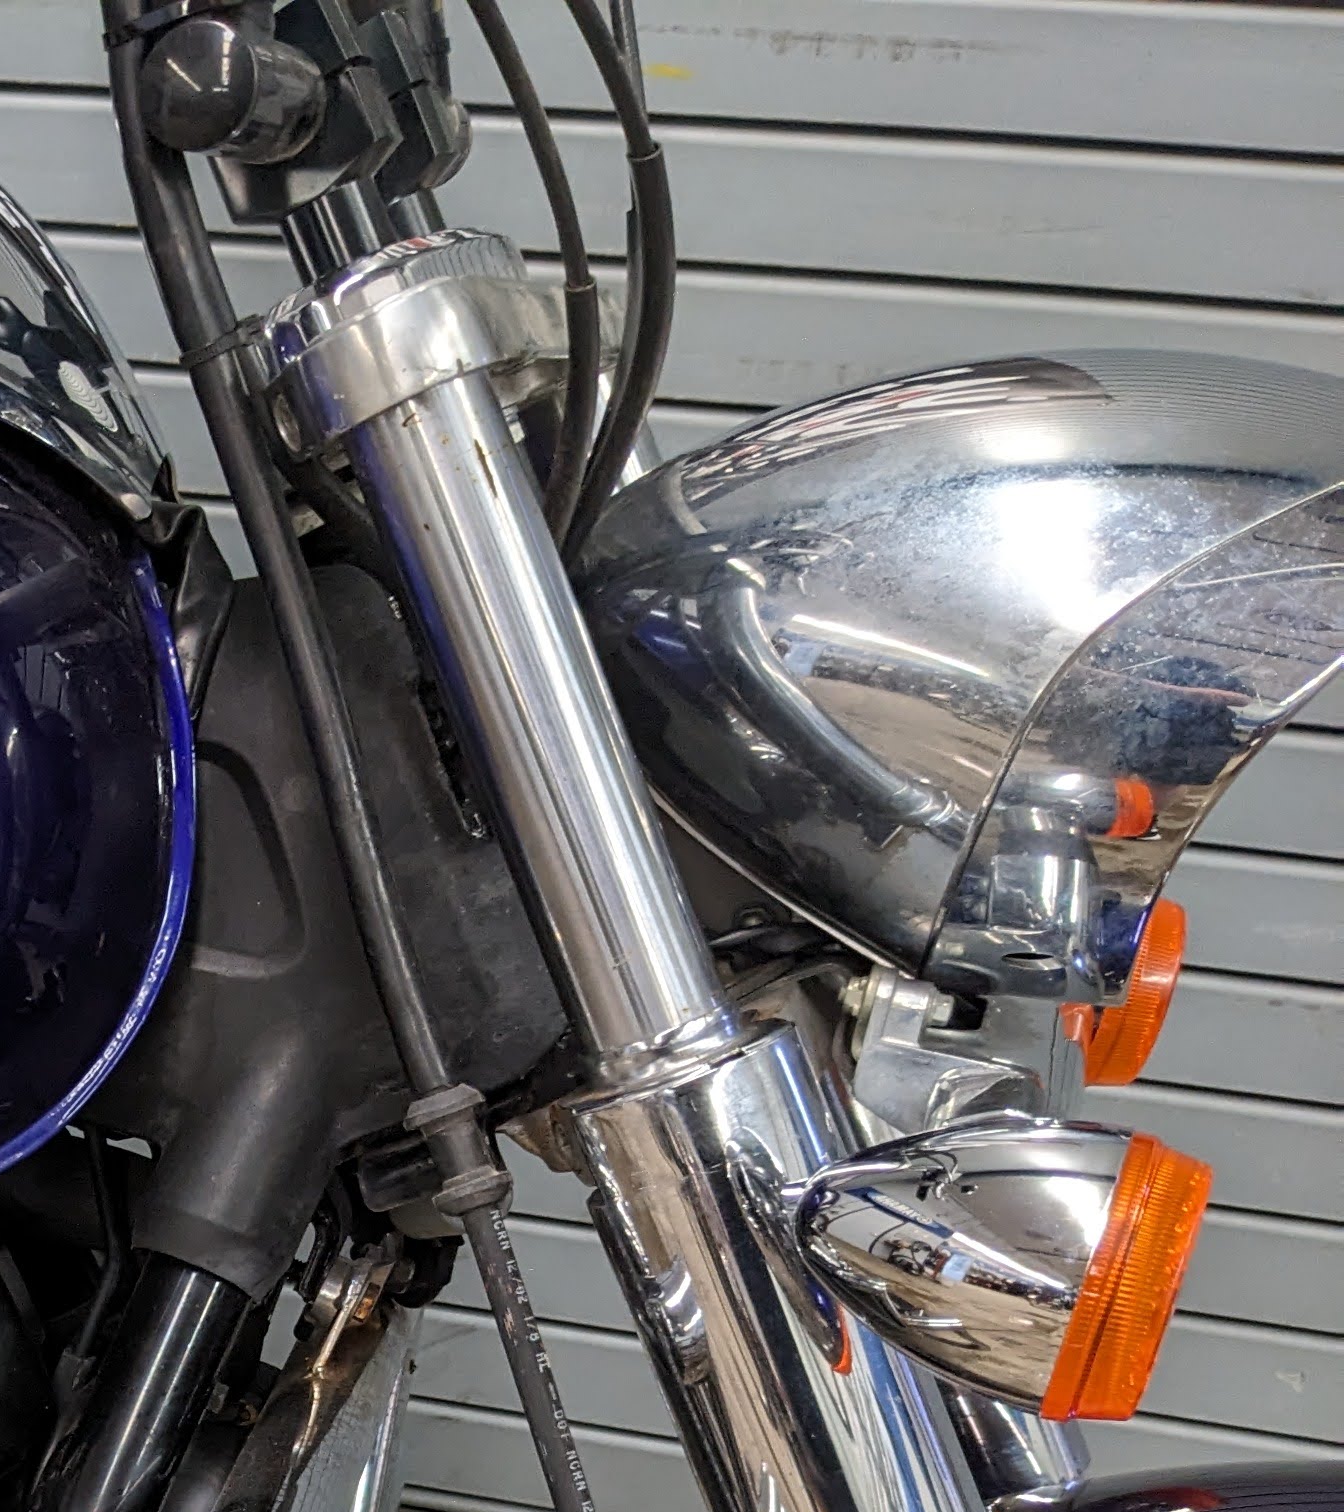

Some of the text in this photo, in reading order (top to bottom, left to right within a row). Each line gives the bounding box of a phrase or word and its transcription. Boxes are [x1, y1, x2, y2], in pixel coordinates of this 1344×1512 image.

[490, 1209, 512, 1251] NCRN
[505, 1259, 529, 1305] 12/02
[523, 1315, 540, 1342] 1/8
[566, 1449, 587, 1492] NCRN
